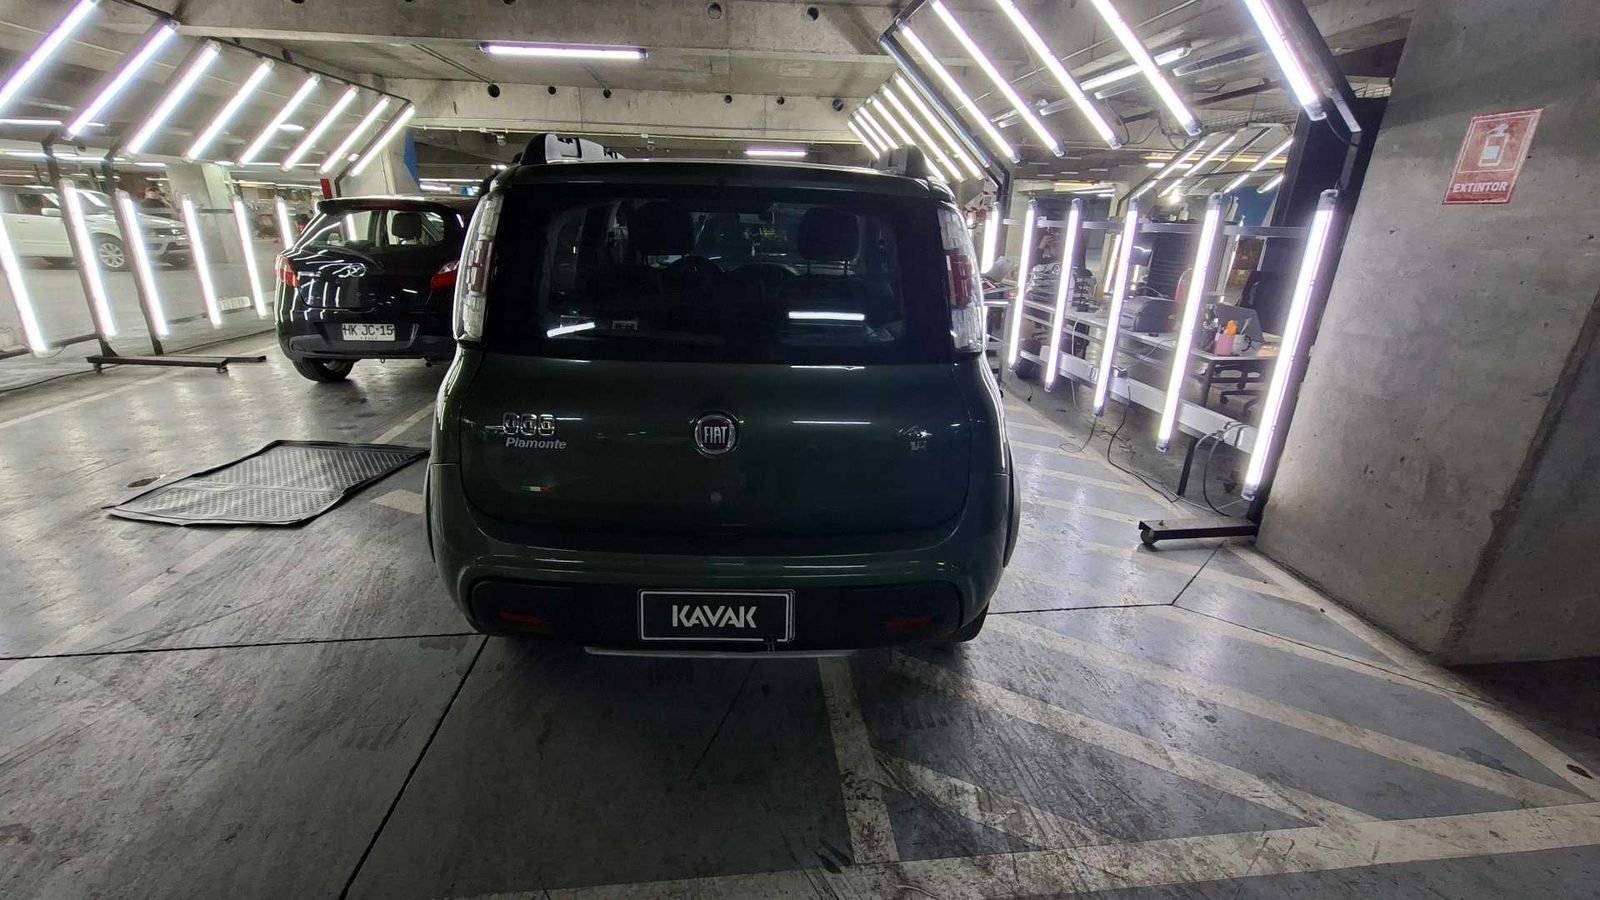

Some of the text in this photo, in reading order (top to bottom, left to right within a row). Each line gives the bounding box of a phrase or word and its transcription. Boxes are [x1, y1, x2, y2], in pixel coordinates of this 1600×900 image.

[1452, 181, 1508, 193] EXTINTOR
[704, 426, 728, 444] FIAT
[672, 605, 758, 628] KAVAK
